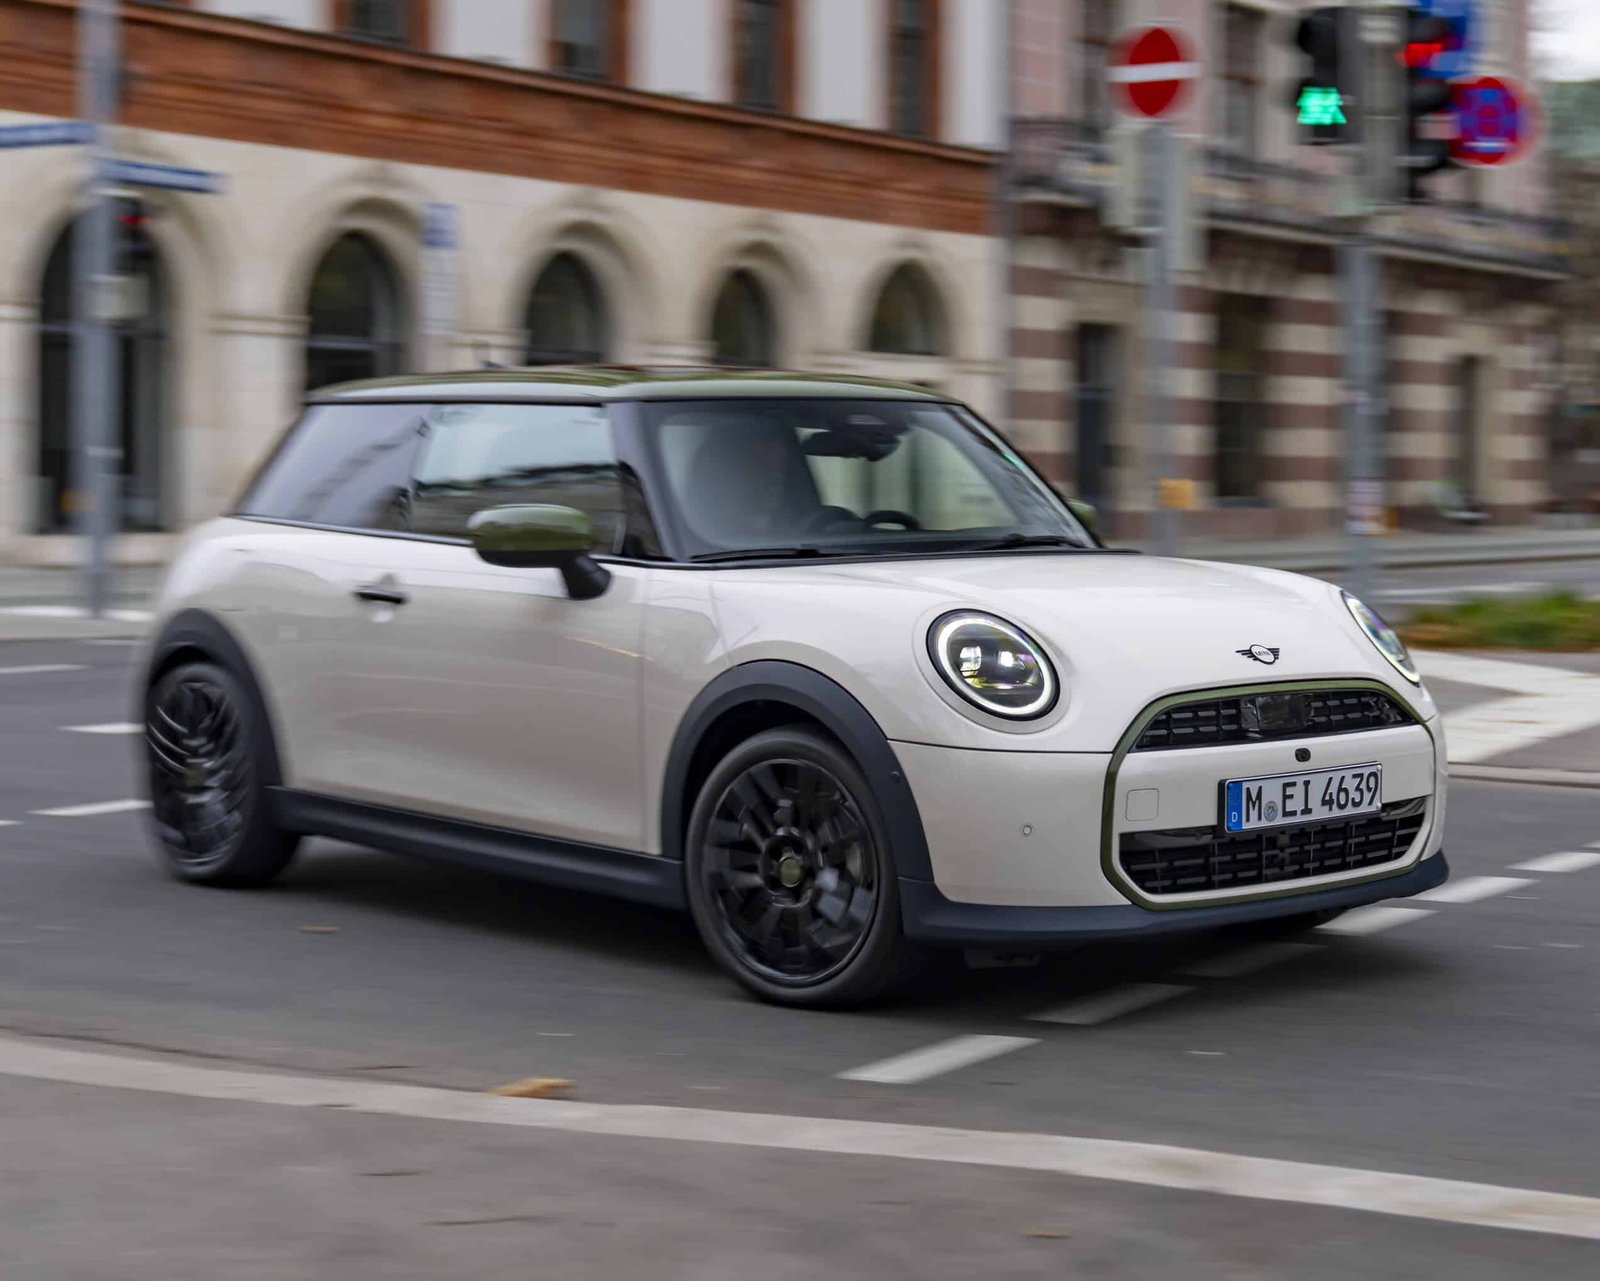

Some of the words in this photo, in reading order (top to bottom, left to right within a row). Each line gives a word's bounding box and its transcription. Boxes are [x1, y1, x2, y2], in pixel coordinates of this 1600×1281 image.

[1246, 785, 1263, 823] M
[1282, 780, 1313, 817] EI
[1321, 771, 1379, 811] 4639
[1231, 812, 1238, 822] D
